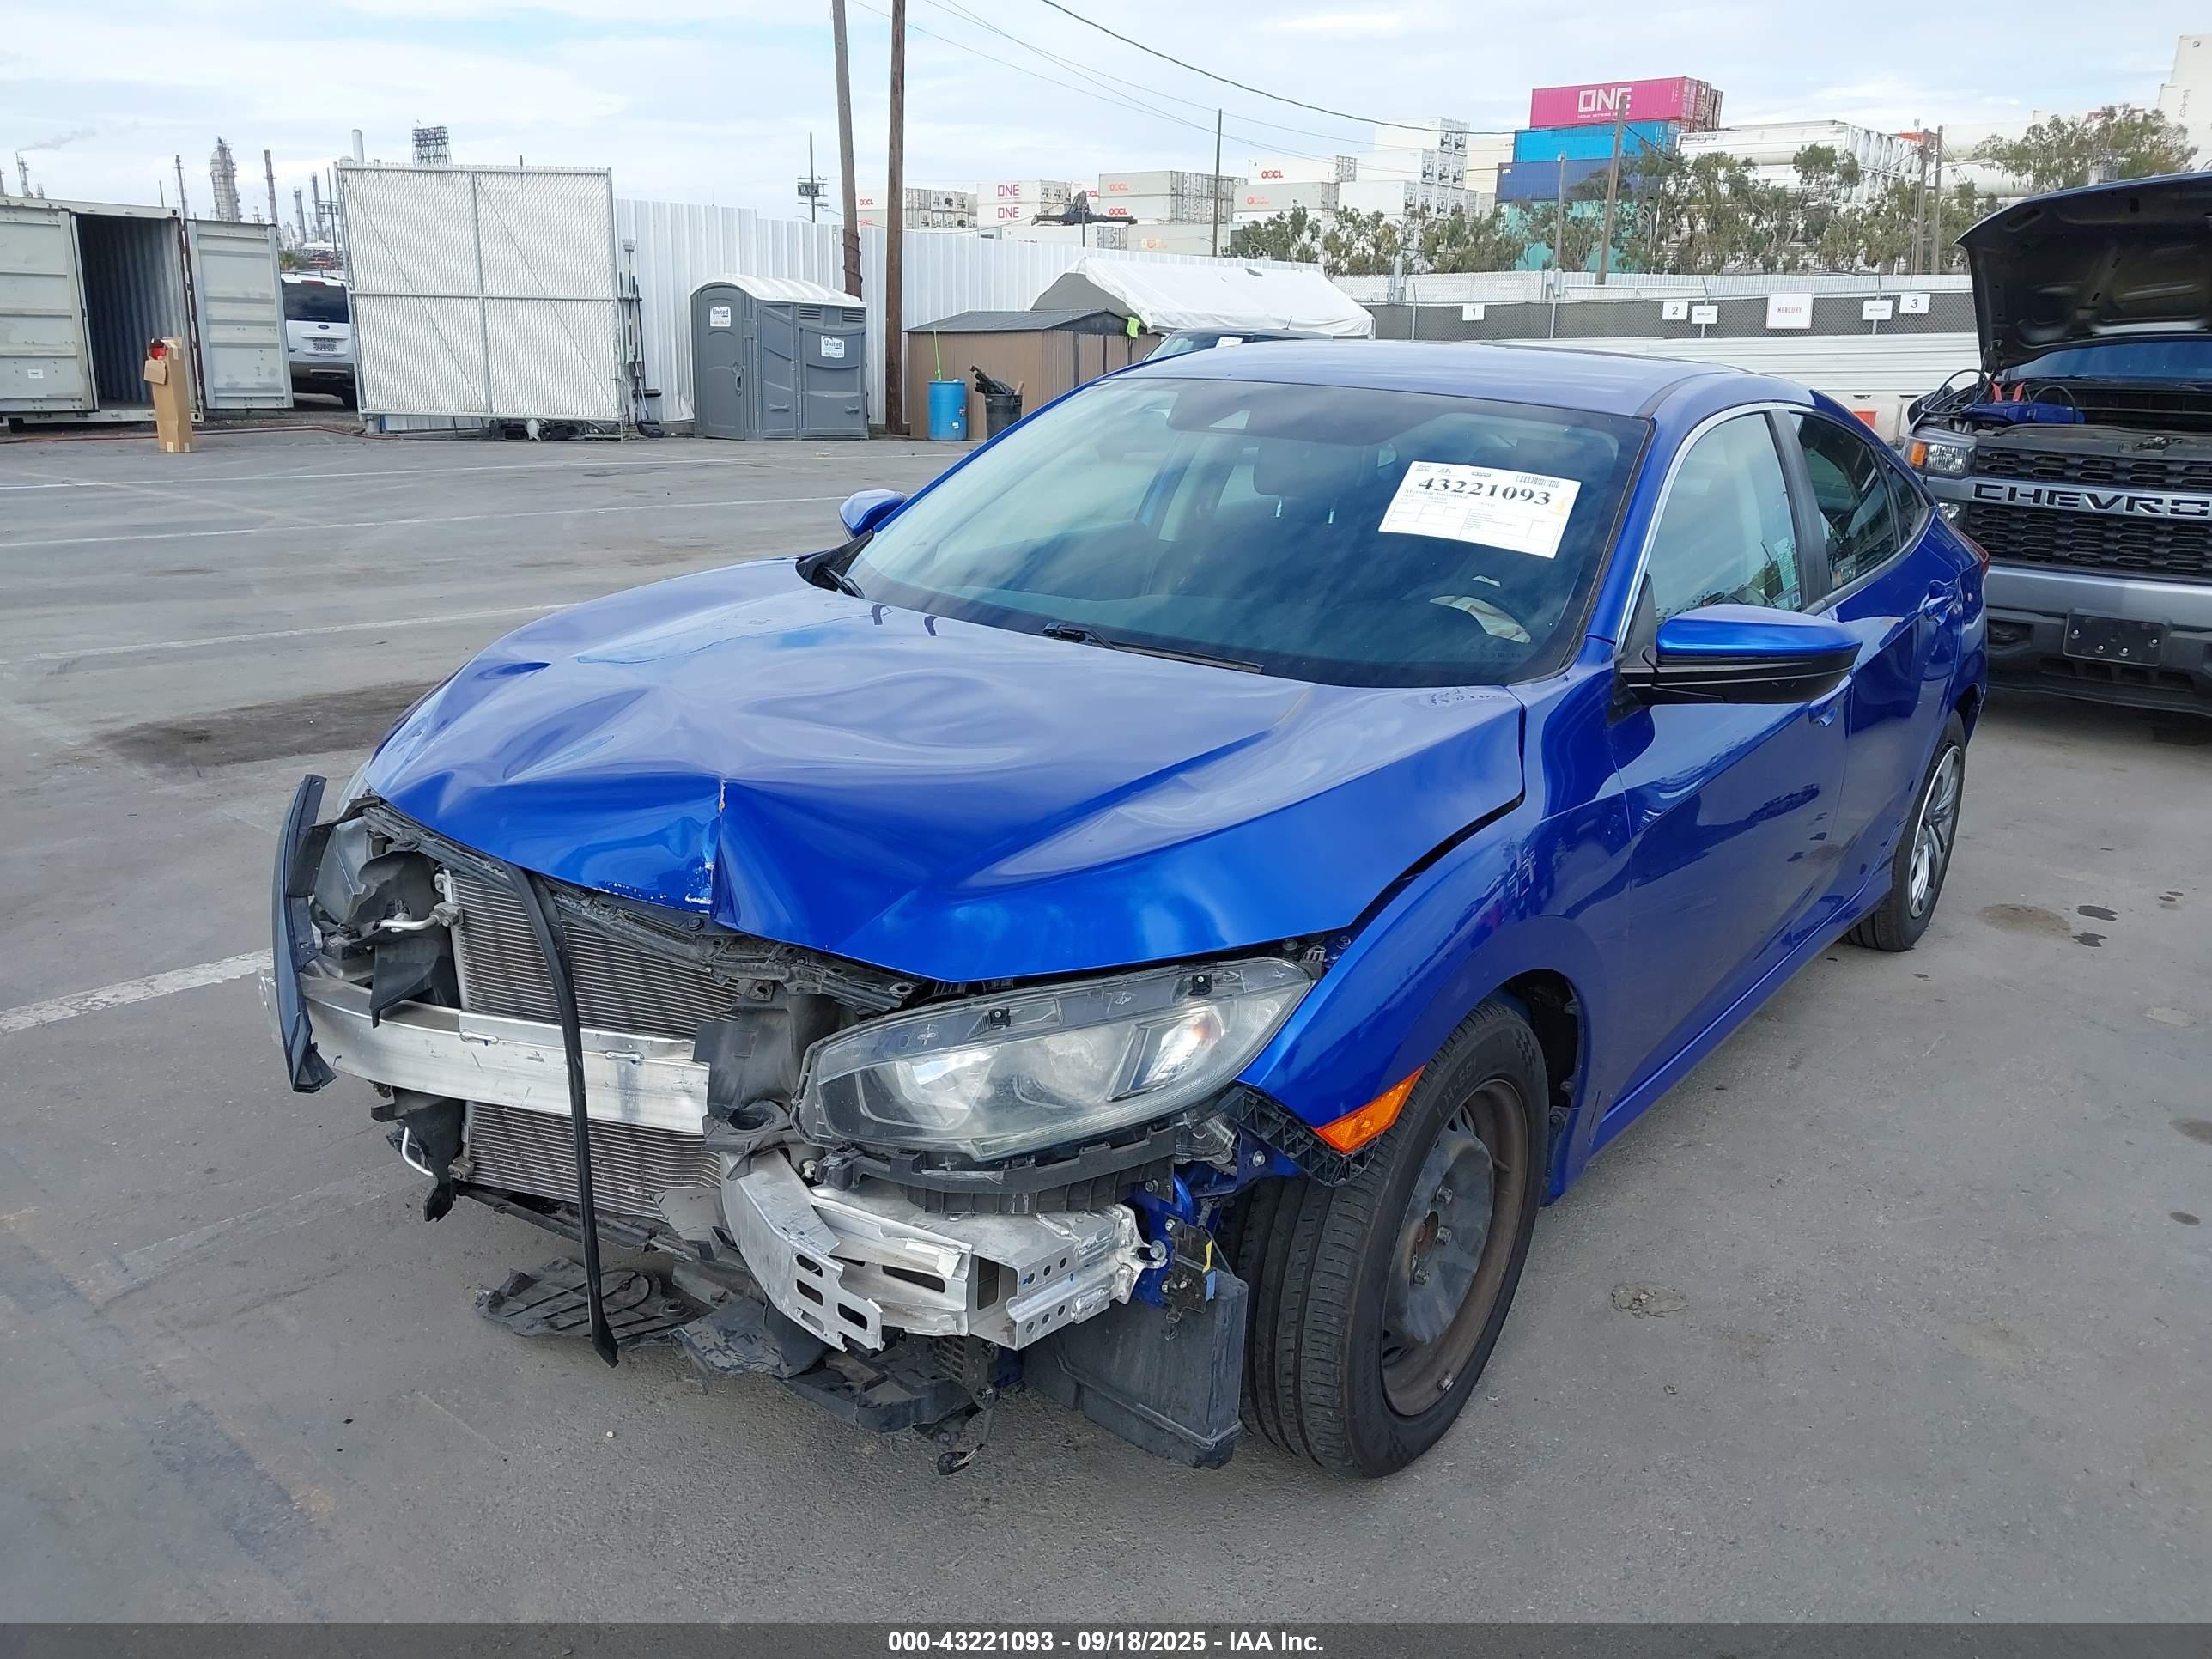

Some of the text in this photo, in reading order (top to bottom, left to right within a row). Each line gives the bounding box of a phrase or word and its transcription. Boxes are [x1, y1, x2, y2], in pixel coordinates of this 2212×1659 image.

[1261, 170, 1284, 179] OOCL
[997, 184, 1020, 197] ONE
[997, 206, 1020, 219] ONE
[1109, 207, 1127, 216] OOCL
[1911, 298, 1919, 309] 3
[1472, 307, 1476, 317] 1
[1672, 306, 1679, 315] 2
[823, 339, 842, 348] United
[1418, 477, 1551, 505] 43221093
[1972, 483, 2211, 517] CHEVRO
